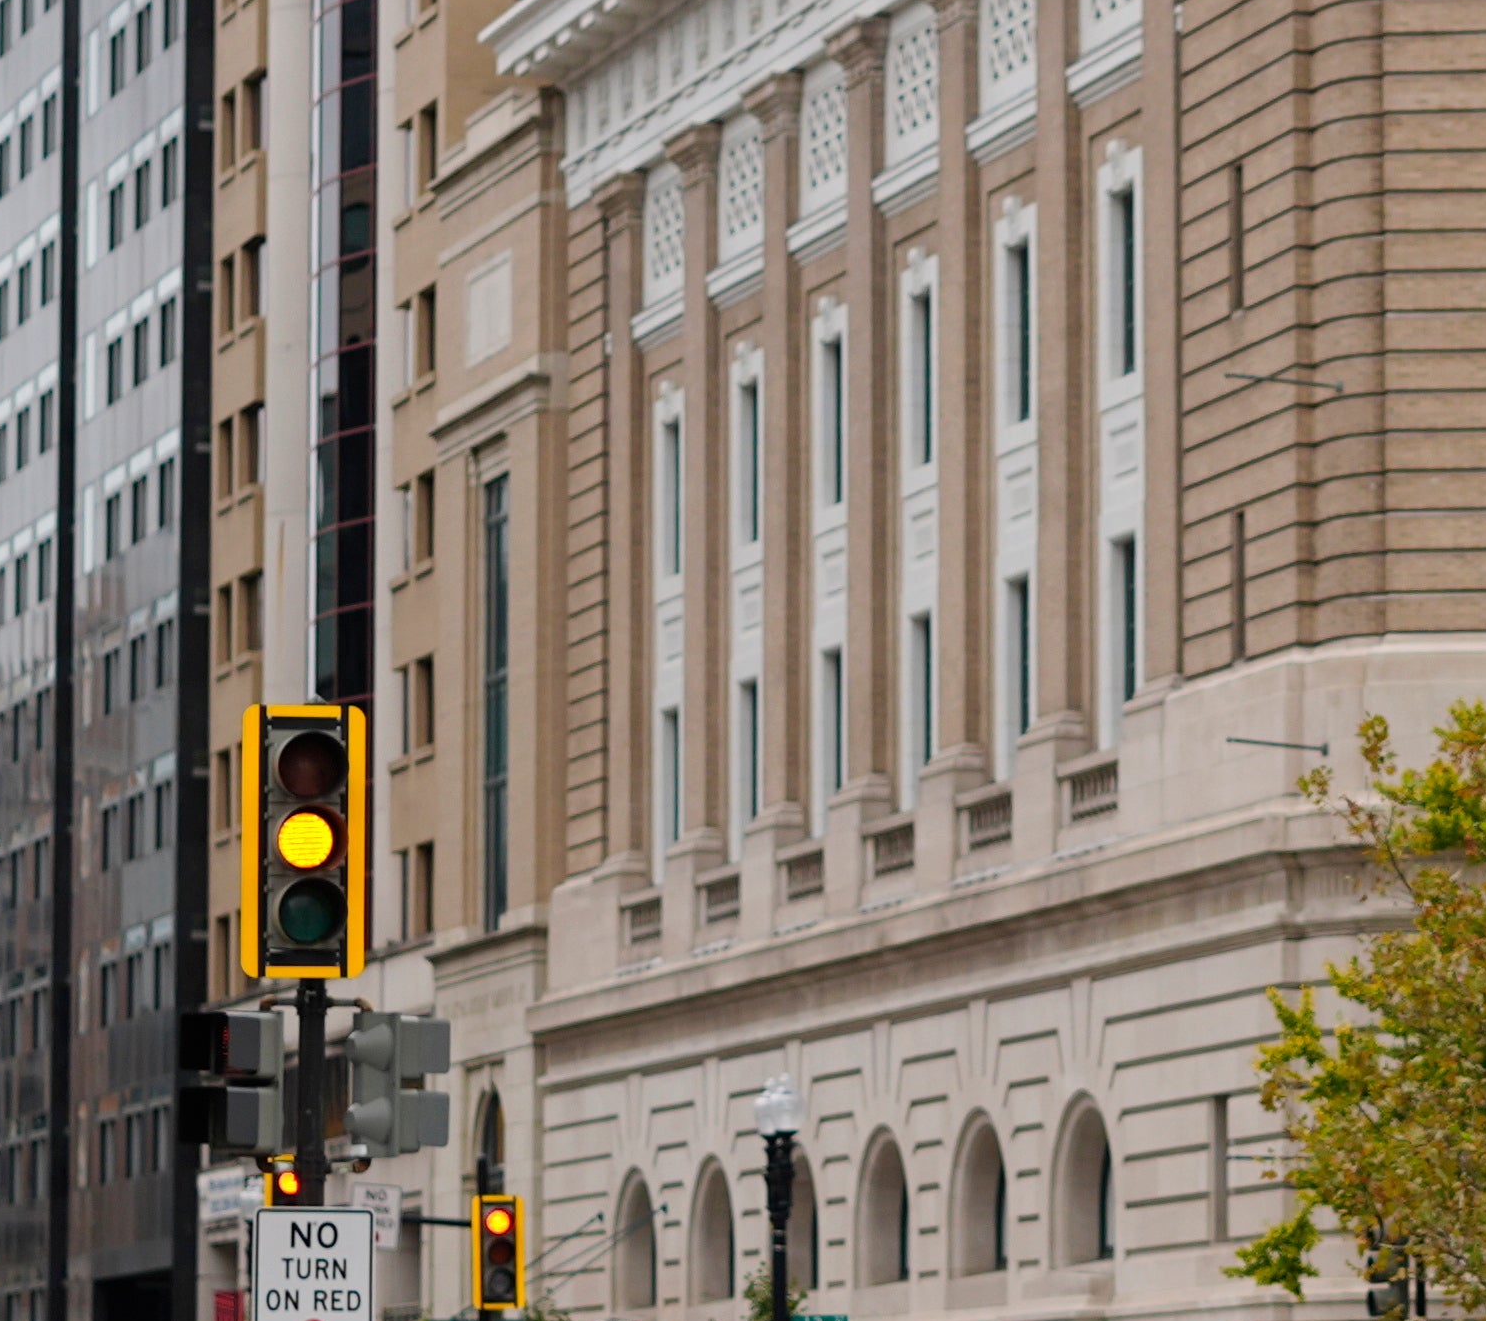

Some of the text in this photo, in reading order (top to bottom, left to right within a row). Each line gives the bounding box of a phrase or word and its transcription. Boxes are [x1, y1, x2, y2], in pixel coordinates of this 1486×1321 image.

[290, 1221, 338, 1249] NO
[282, 1257, 347, 1280] TURN
[266, 1288, 361, 1311] ON RED
